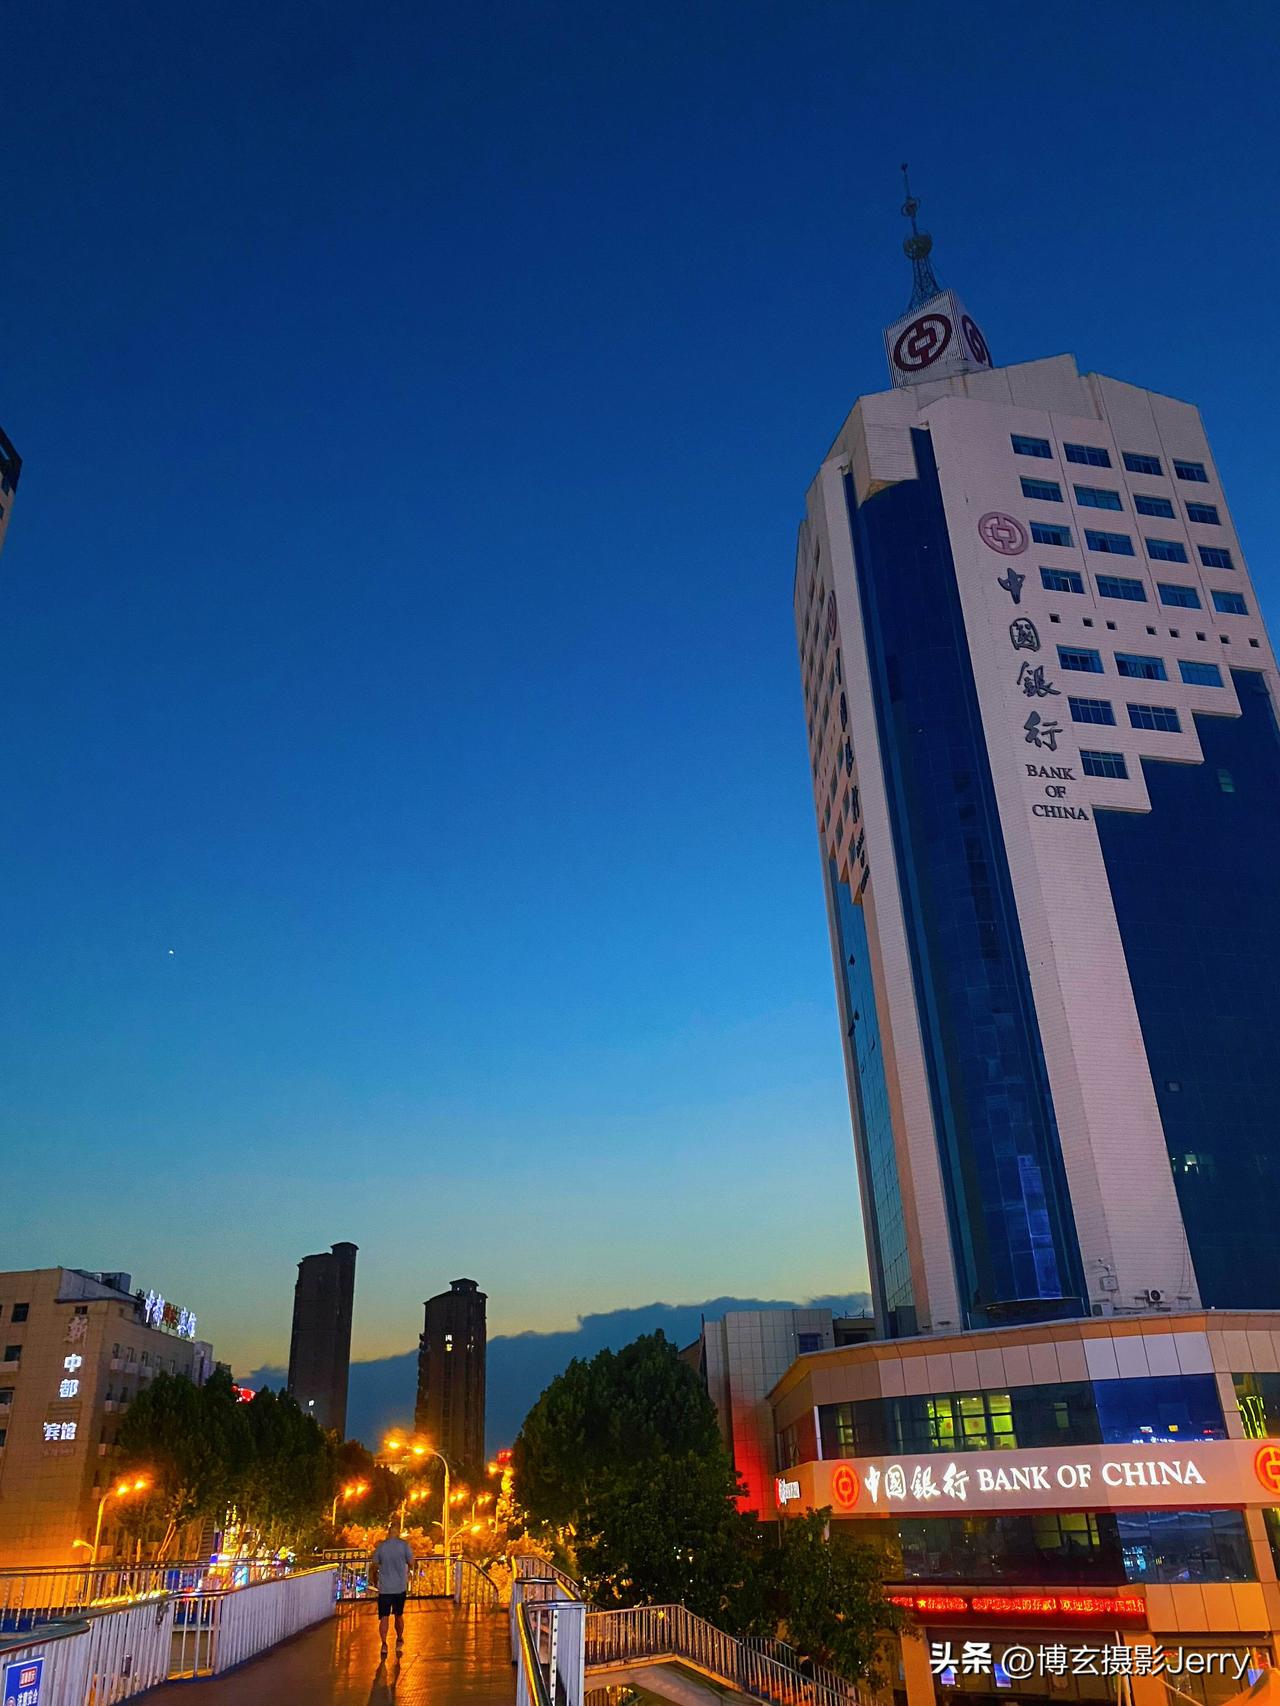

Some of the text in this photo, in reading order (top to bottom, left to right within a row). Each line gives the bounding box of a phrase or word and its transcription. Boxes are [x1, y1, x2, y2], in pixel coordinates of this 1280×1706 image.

[1026, 764, 1077, 781] BANK
[1045, 784, 1067, 799] OF
[1032, 804, 1090, 821] CHINA
[43, 1421, 78, 1441] 宾馆
[976, 1466, 1051, 1491] BANK
[1056, 1464, 1092, 1489] OF
[1101, 1460, 1207, 1487] CHINA
